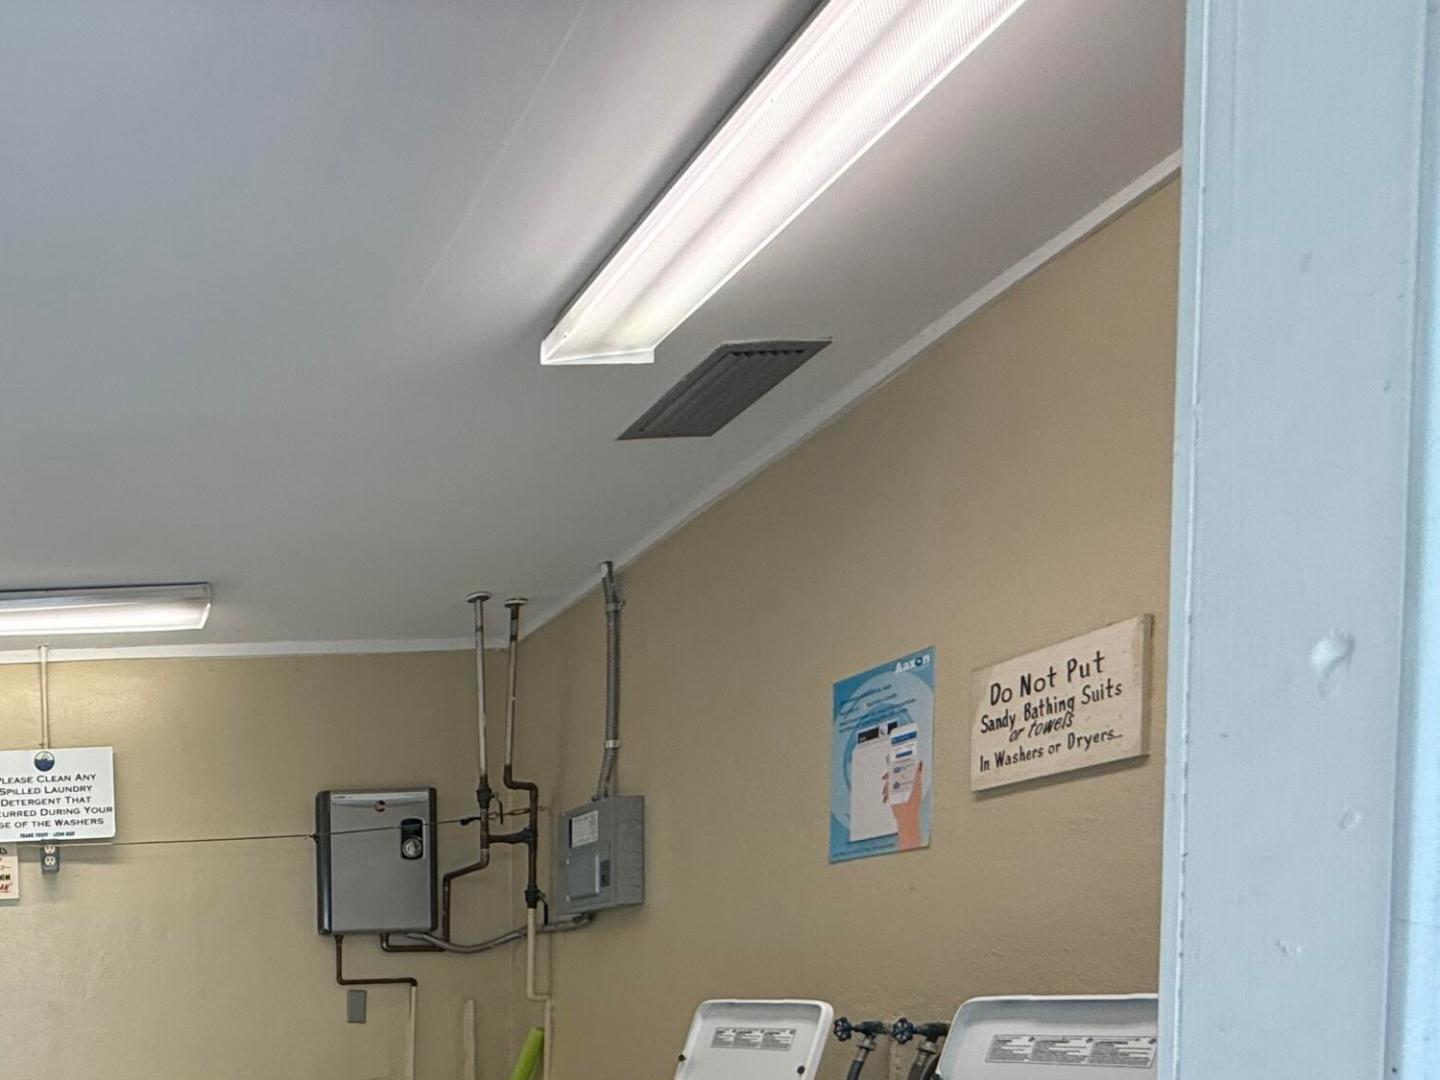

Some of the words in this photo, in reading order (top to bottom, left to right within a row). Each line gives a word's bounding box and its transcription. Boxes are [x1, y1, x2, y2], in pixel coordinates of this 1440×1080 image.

[895, 653, 930, 674] Aaxon
[990, 683, 1012, 706] Do
[1020, 666, 1057, 697] Not
[1067, 650, 1105, 683] Put
[980, 709, 1016, 734] Sandy
[1024, 695, 1076, 722] Bathing
[1081, 678, 1122, 705] Suits
[1009, 726, 1025, 743] or
[1027, 711, 1075, 738] towels
[980, 755, 990, 772] In
[994, 745, 1044, 768] Washers
[1048, 742, 1062, 755] or
[36, 774, 71, 783] CLEAN
[75, 773, 96, 781] ANY
[44, 785, 93, 794] LAUNDRY
[0, 797, 61, 807] DETERGENT
[64, 796, 92, 804] THAT
[40, 808, 81, 816] DURING
[84, 806, 113, 814] YOUR
[31, 819, 51, 827] THE
[54, 818, 104, 827] WASHERS
